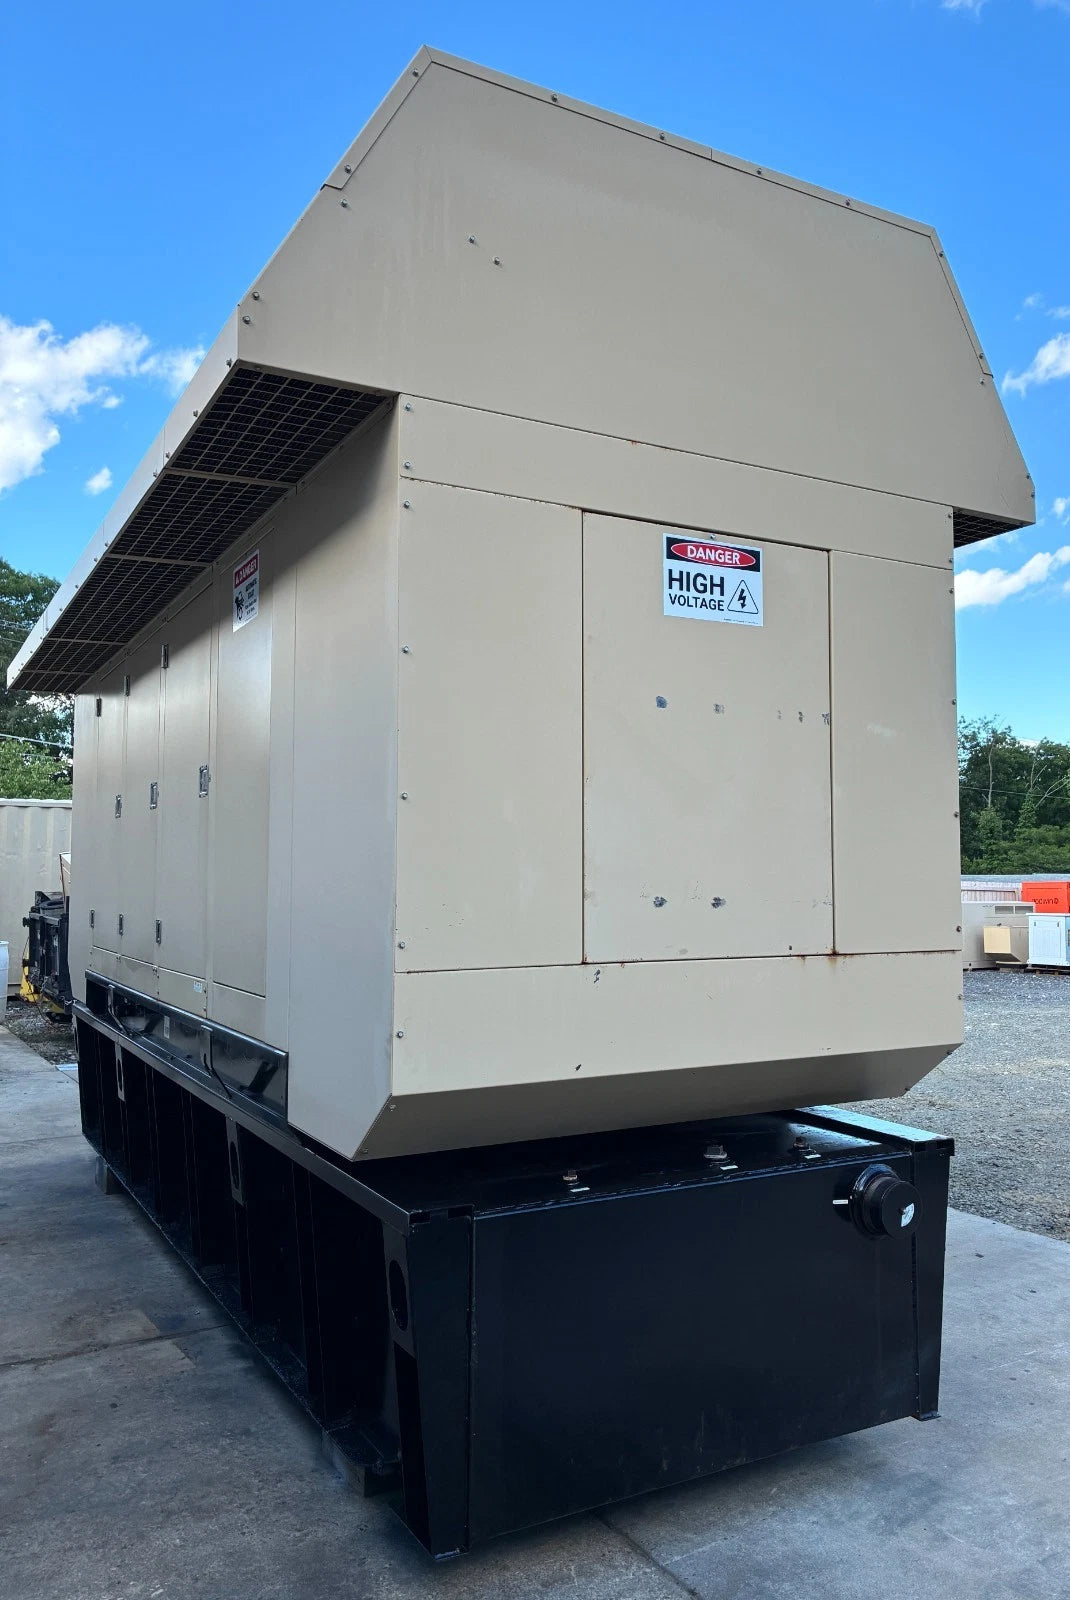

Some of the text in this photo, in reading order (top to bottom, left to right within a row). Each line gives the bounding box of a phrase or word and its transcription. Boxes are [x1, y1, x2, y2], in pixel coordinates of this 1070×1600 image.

[687, 545, 741, 565] DANGER
[668, 568, 725, 596] HIGH
[668, 593, 725, 612] VOLTAGE
